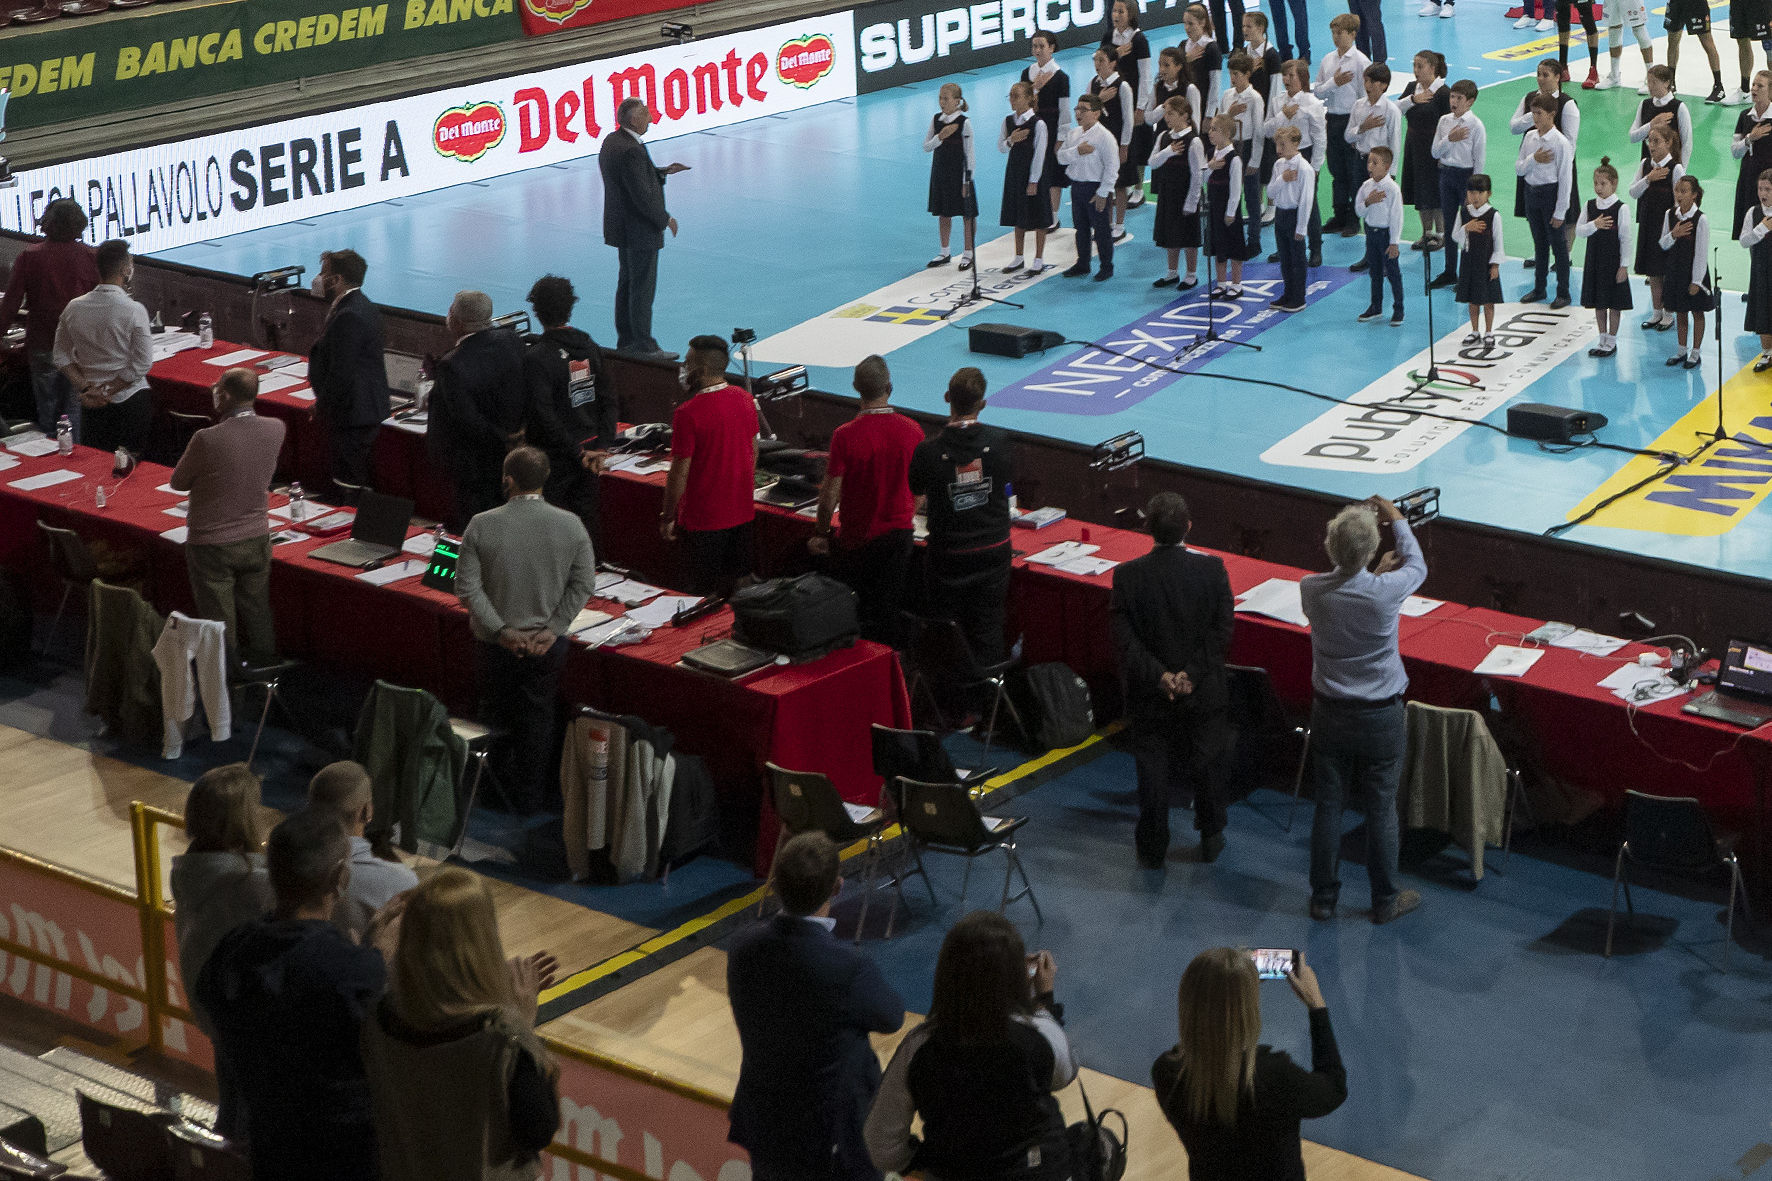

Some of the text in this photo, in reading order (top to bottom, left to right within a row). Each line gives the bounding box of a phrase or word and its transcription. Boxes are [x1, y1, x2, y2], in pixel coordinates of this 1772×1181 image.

[115, 28, 243, 80] BANCA
[253, 4, 388, 56] CREDEM
[780, 47, 832, 72] Del Monte
[438, 117, 503, 141] Del Monte
[513, 47, 769, 154] Del Monte
[88, 155, 223, 243] PALLAVOLO
[229, 128, 364, 212] SERIE
[381, 119, 409, 181] A
[1022, 278, 1284, 397] NEXIDIA
[1508, 316, 1599, 381] COMUNICAZIO
